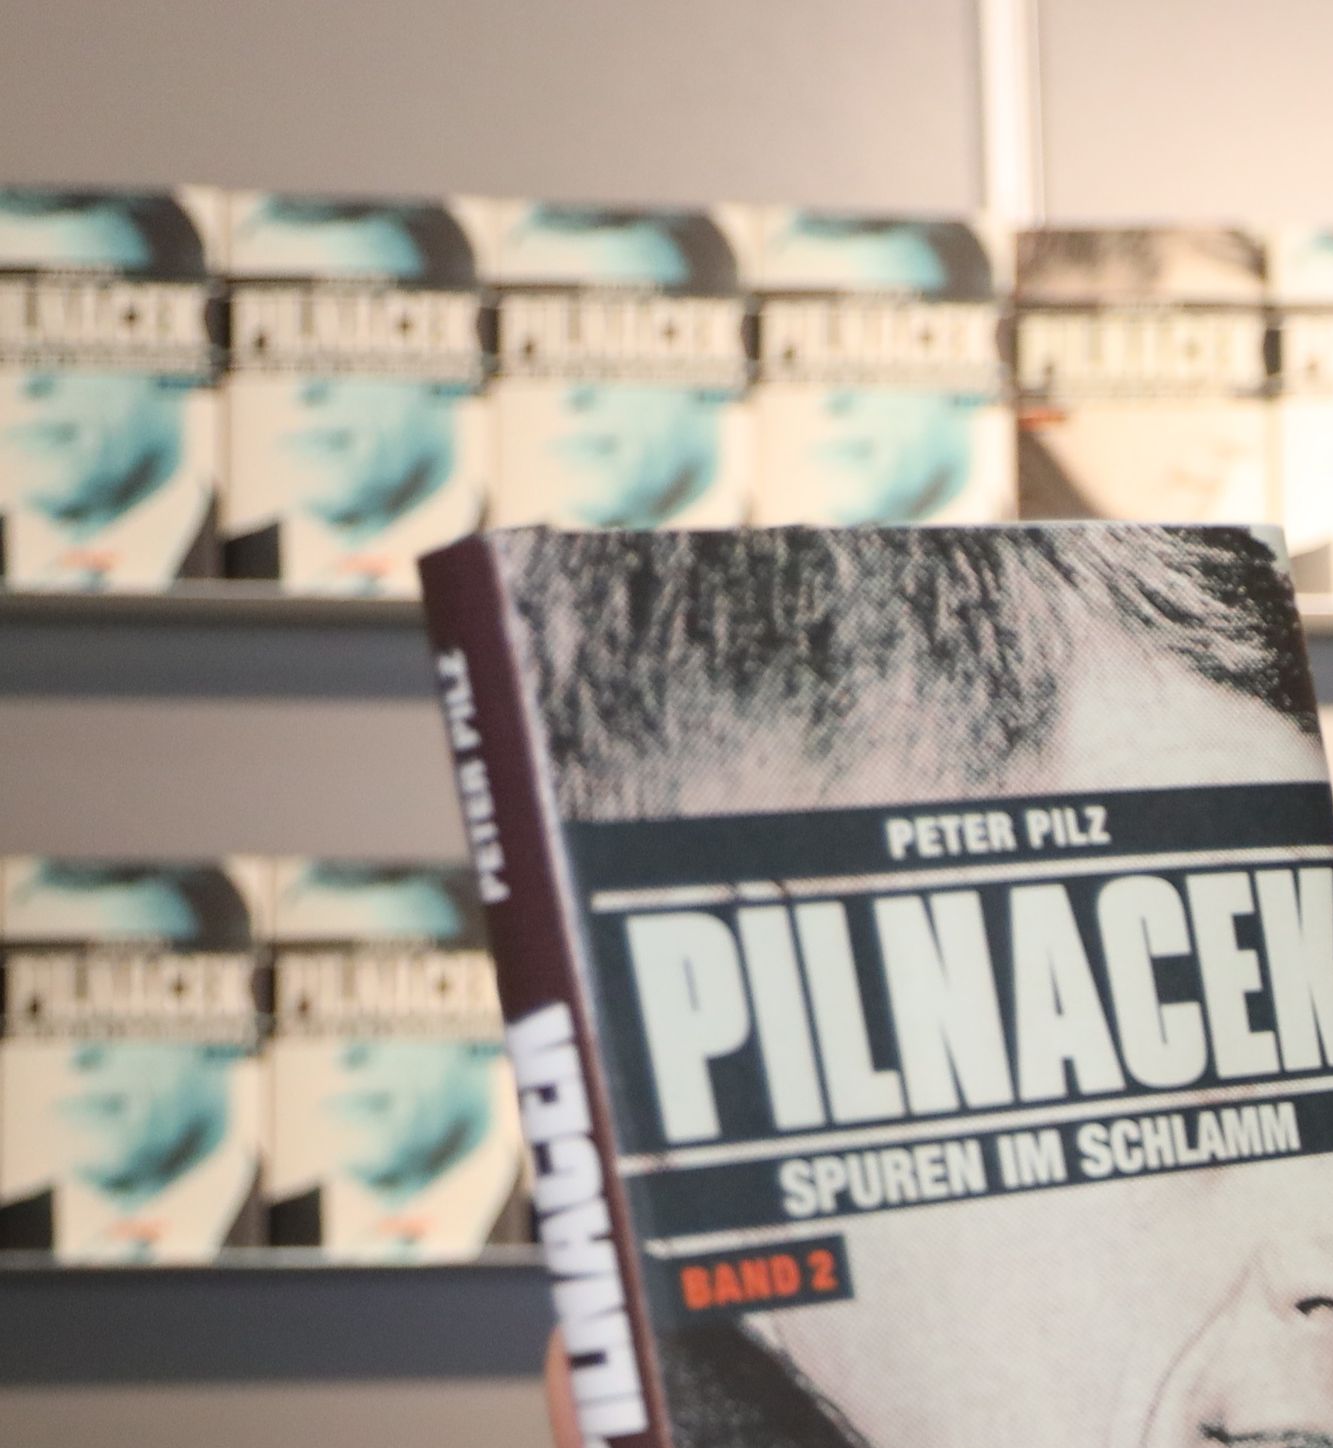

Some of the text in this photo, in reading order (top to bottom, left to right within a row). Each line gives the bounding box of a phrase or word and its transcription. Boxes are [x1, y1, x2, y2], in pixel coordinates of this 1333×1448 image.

[887, 807, 1110, 860] PETER PILZ
[779, 1101, 1300, 1219] SPUREN IM SCHLAMM
[680, 1249, 838, 1310] BAND 2
